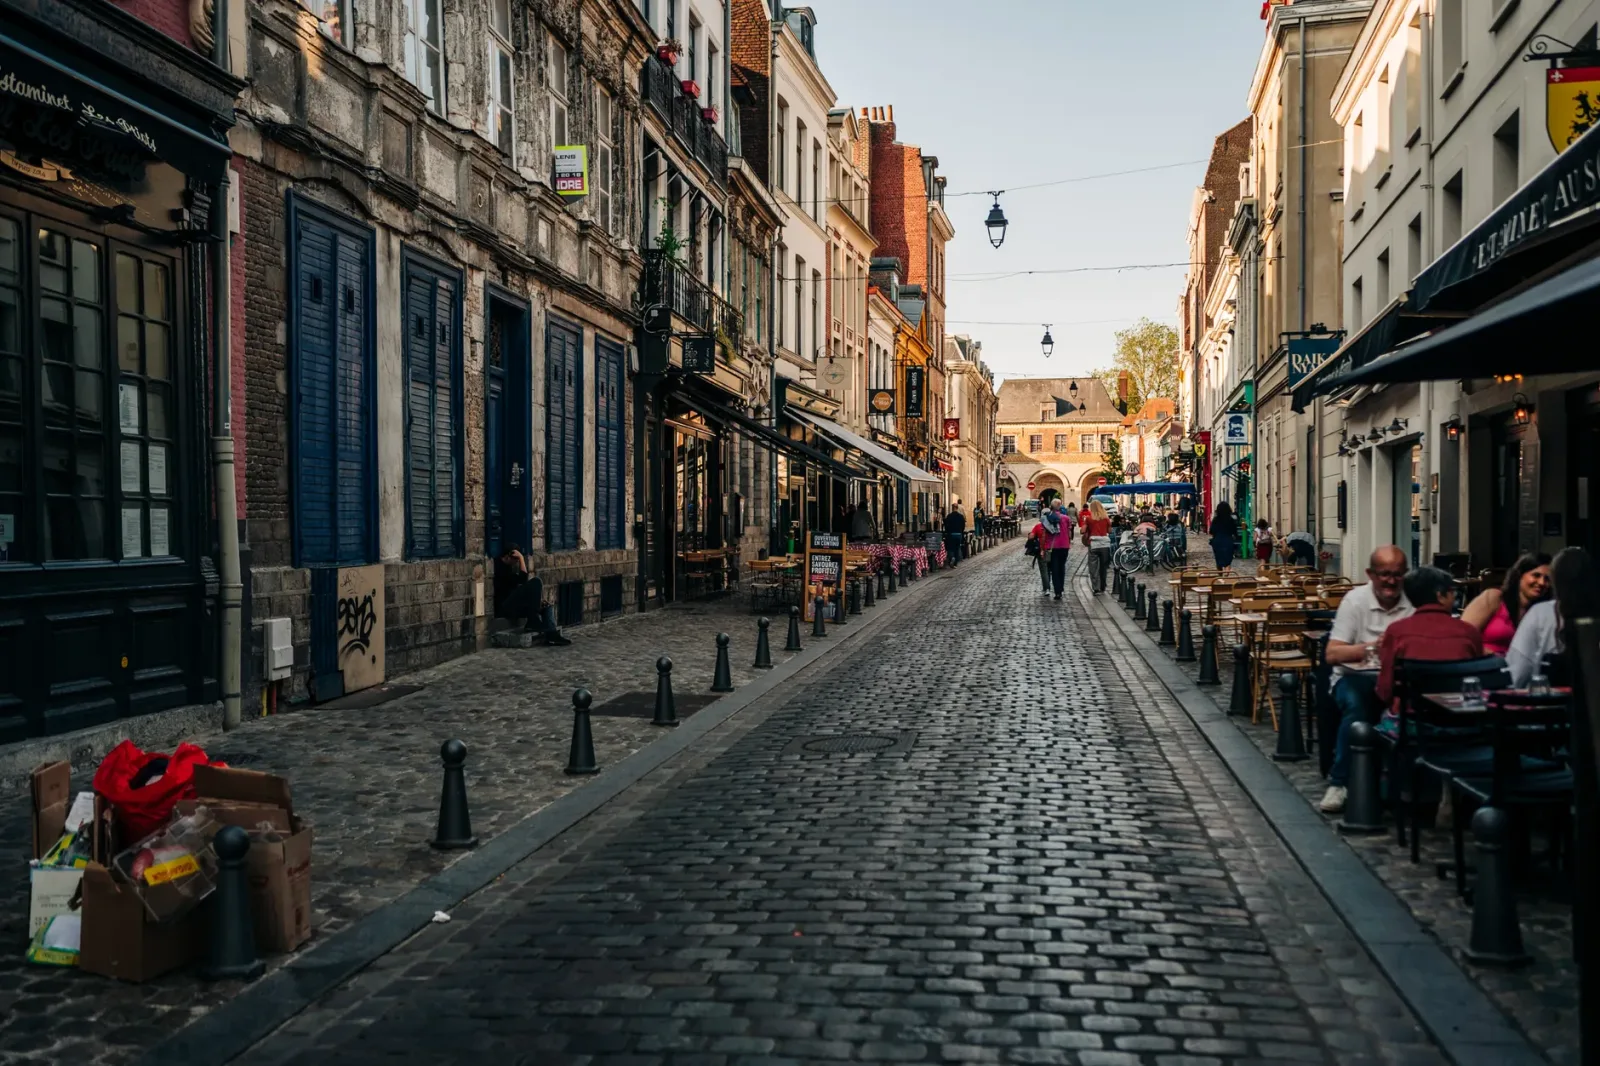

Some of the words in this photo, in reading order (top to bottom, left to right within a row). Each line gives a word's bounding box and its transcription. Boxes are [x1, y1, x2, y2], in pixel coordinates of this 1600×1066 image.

[0, 64, 73, 112] staminet
[1554, 169, 1579, 211] AU
[1584, 151, 1600, 191] S
[1291, 353, 1333, 366] DAIK
